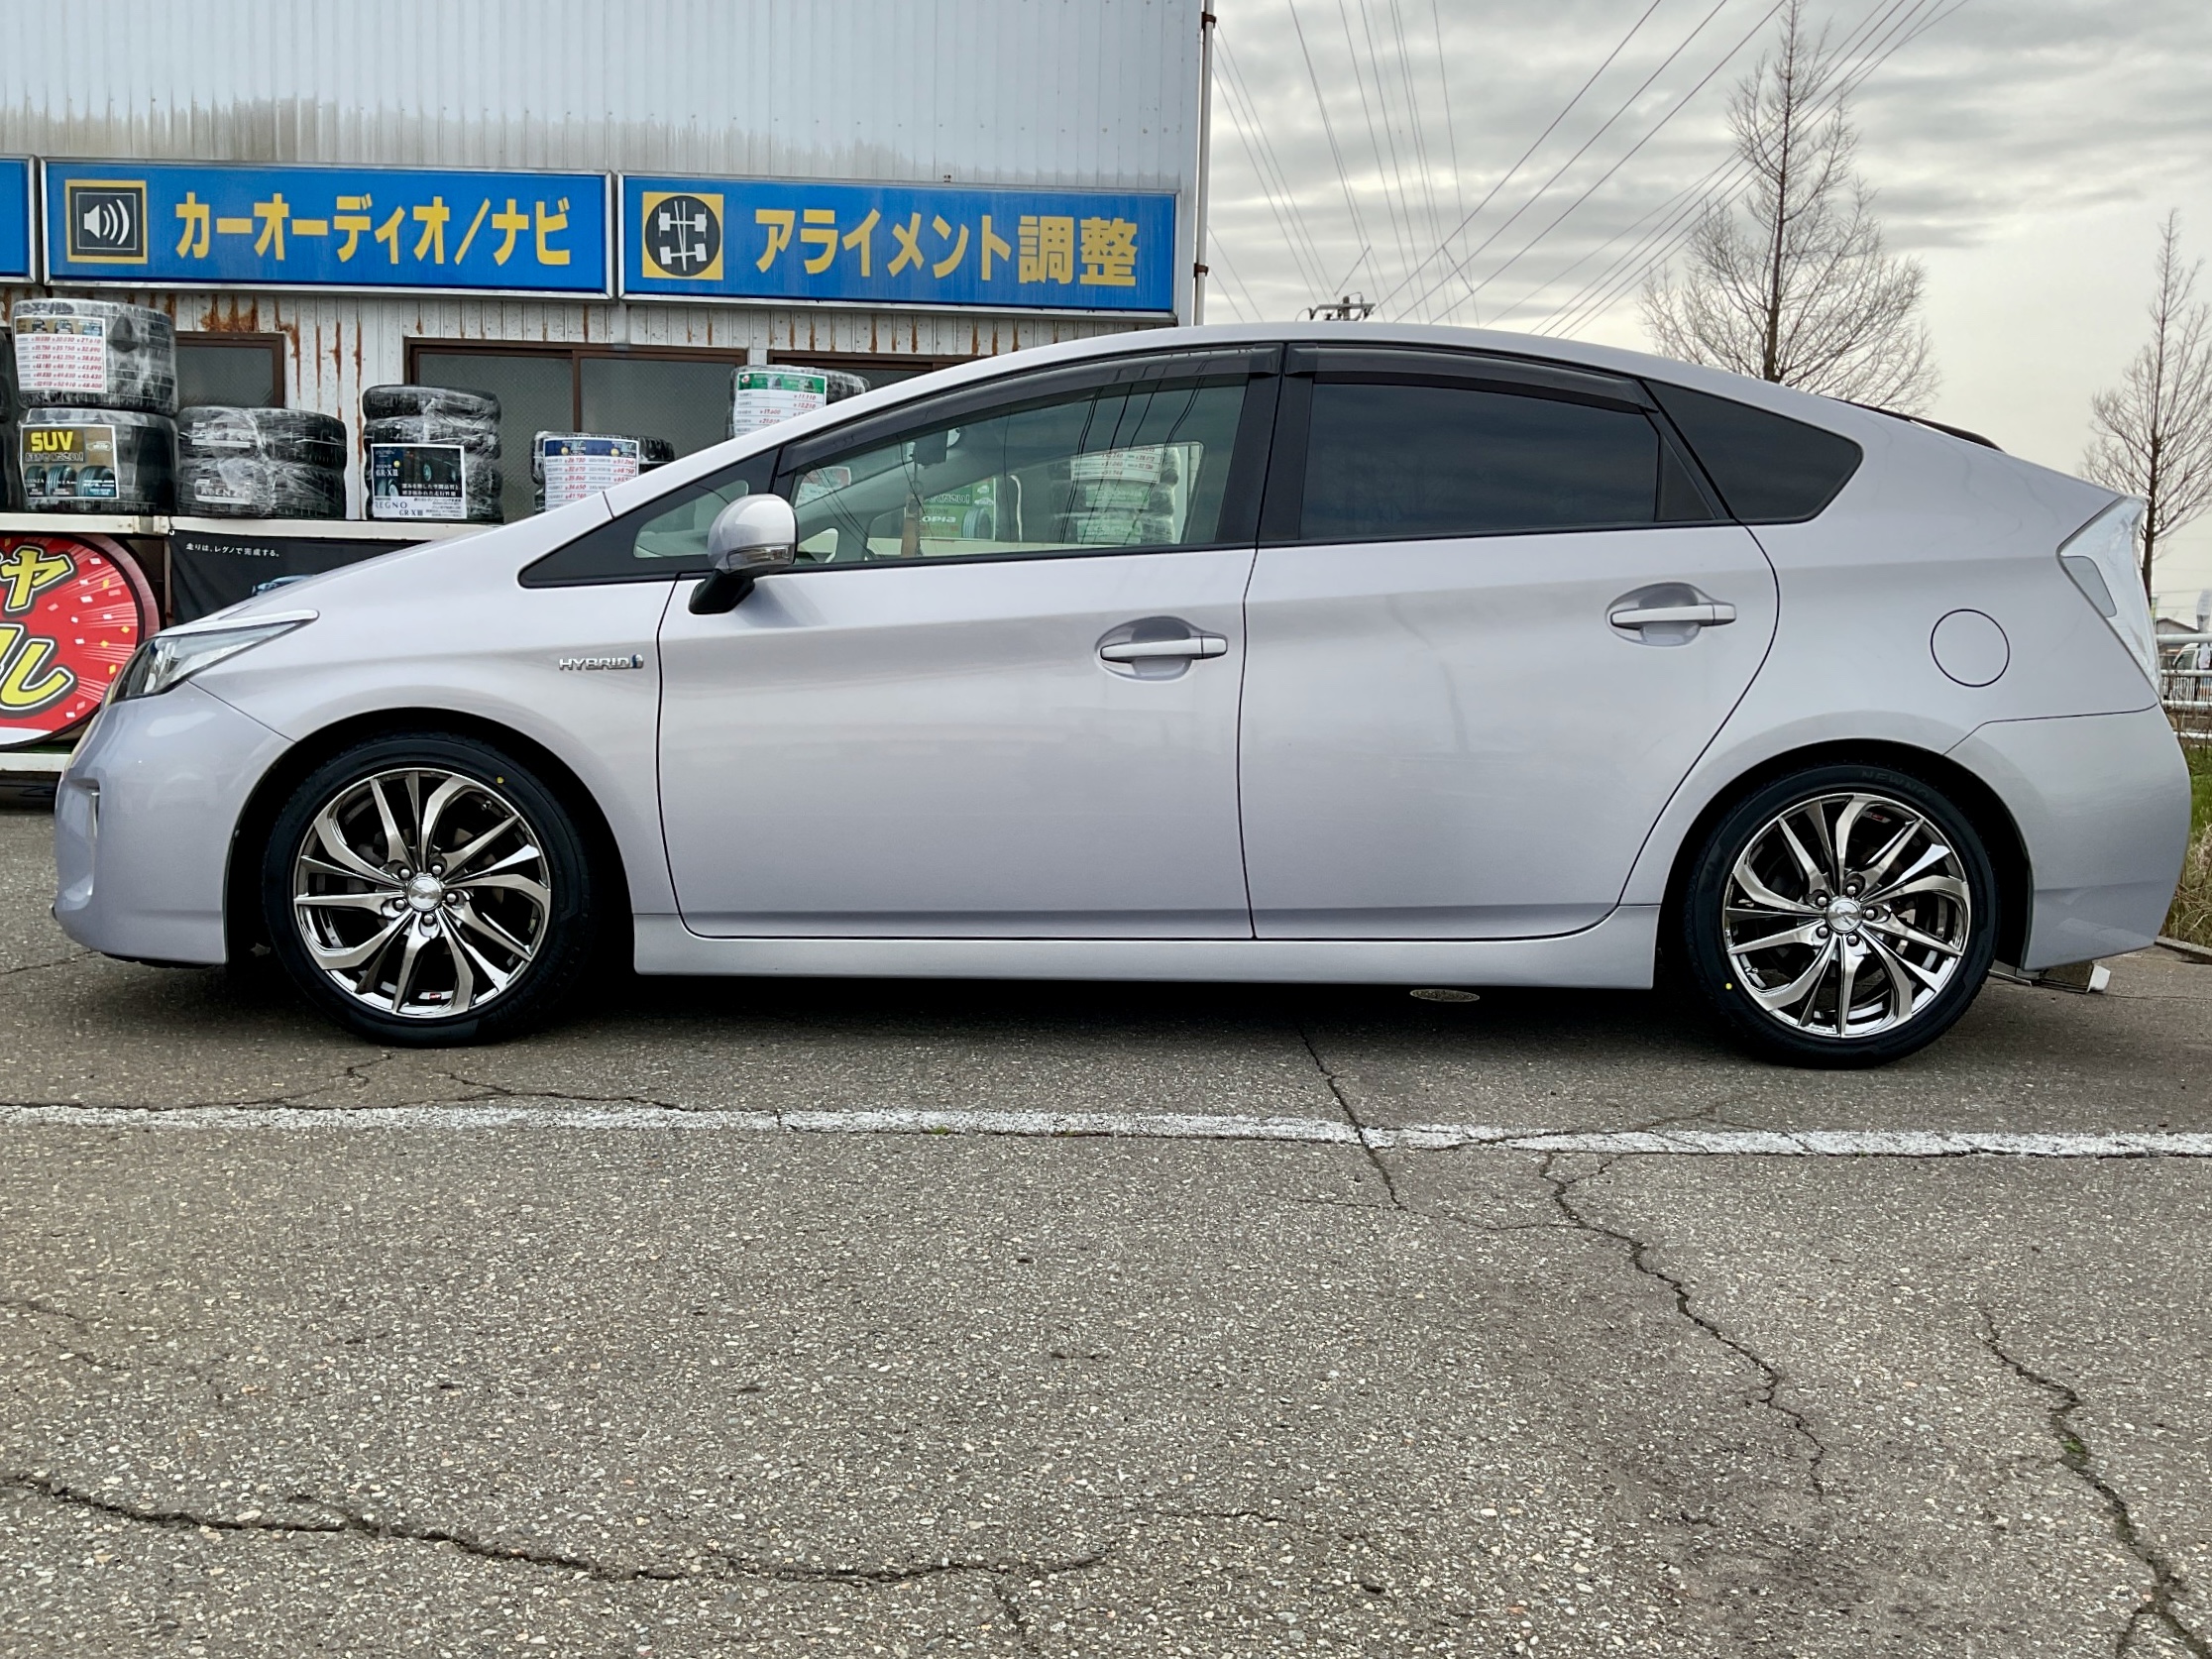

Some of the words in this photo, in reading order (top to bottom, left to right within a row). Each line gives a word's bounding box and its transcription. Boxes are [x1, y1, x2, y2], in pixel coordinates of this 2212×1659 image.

[175, 191, 571, 267] カーオーディオ/ナビ
[754, 207, 1139, 287] アライメント調整
[31, 431, 73, 452] SUV
[185, 542, 279, 557] 走りは、レグノで完成する。
[559, 657, 629, 670] HYBRID
